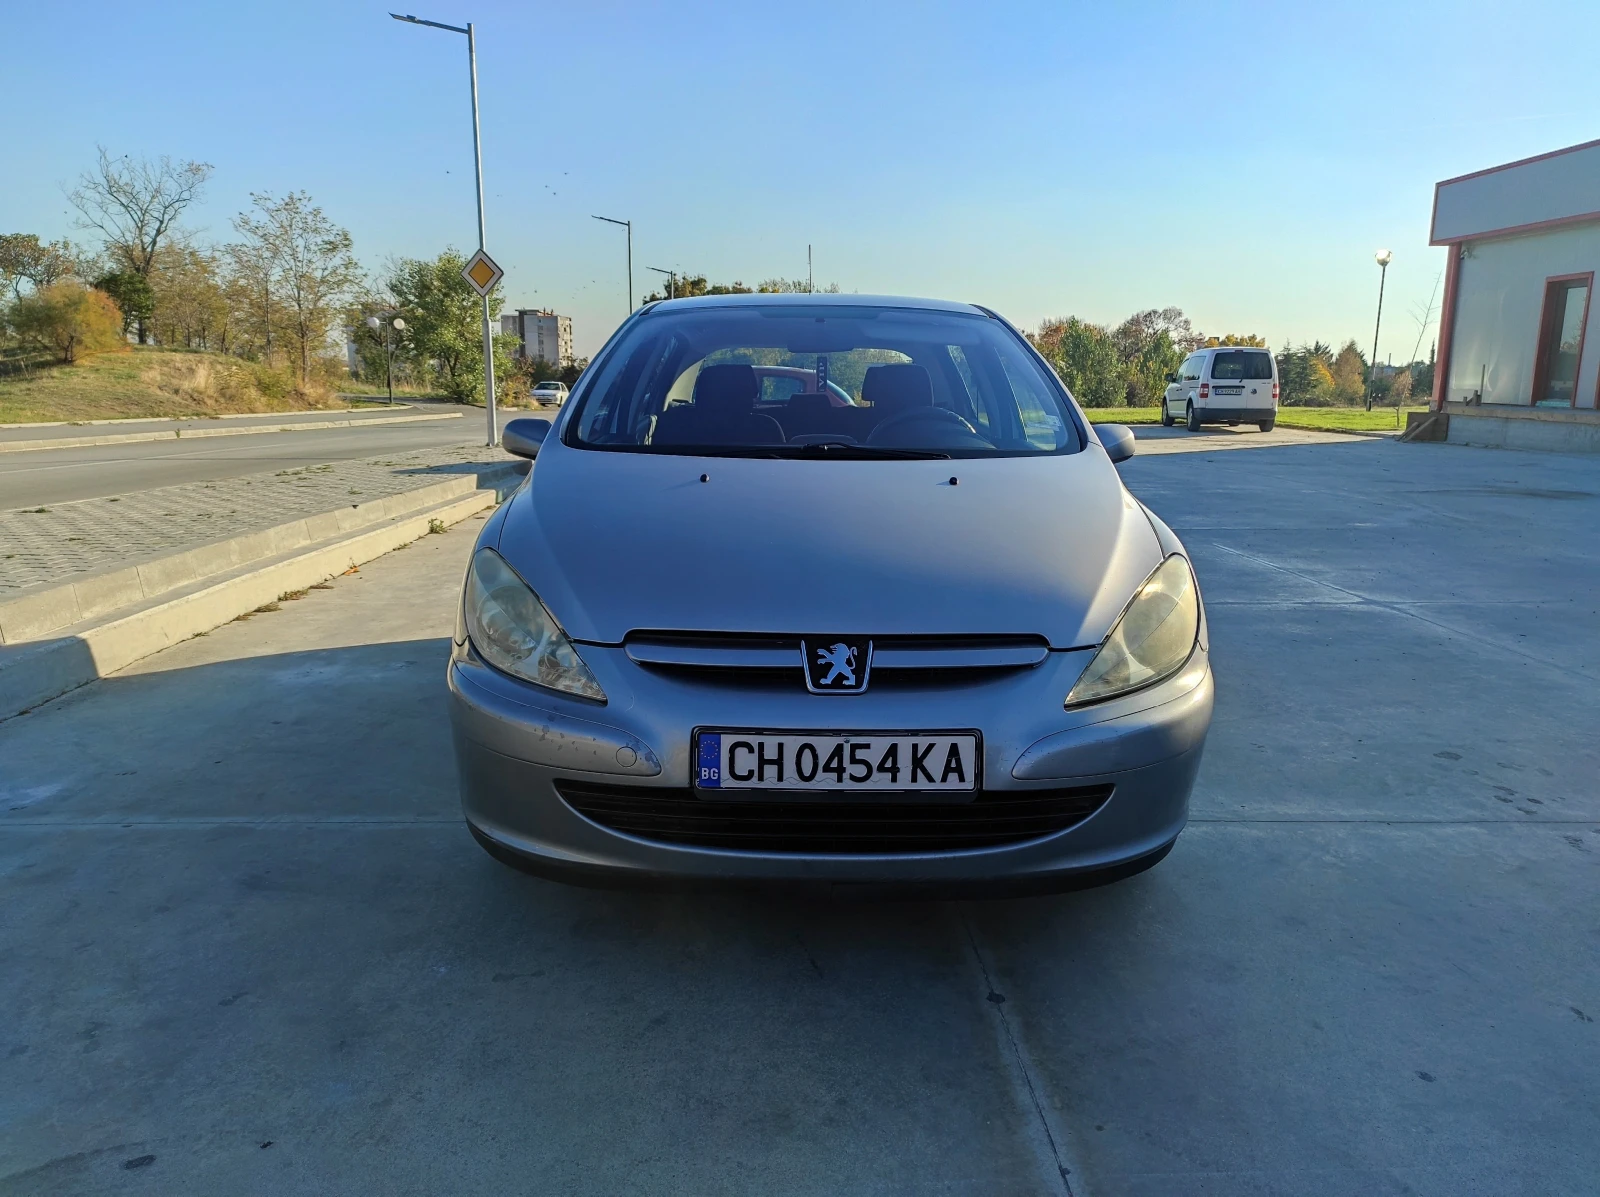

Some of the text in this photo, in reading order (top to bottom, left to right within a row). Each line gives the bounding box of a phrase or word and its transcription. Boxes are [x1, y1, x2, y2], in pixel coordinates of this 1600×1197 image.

[701, 767, 719, 780] BG
[728, 741, 966, 784] CH 0454 KA
